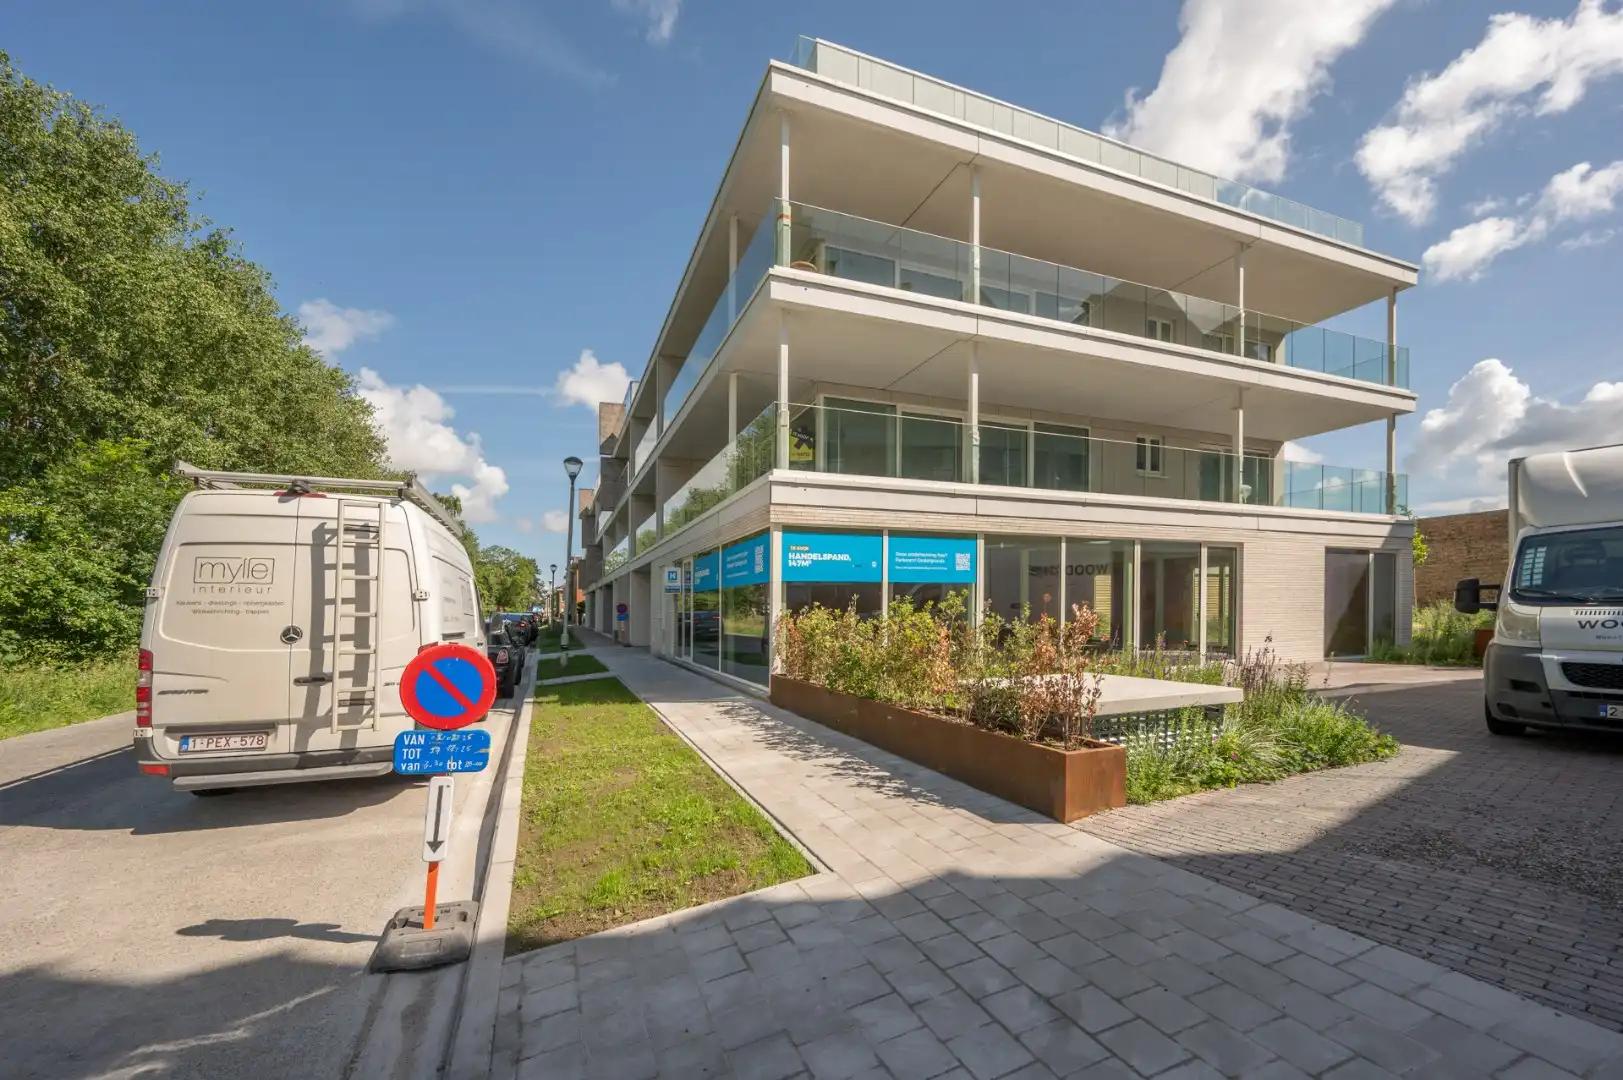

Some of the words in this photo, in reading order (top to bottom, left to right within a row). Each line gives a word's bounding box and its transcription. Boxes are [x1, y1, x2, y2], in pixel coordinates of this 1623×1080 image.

[788, 552, 852, 561] HANDELSPAND,
[198, 557, 269, 584] mylle
[192, 585, 272, 594] interieur
[1577, 619, 1623, 630] WO
[191, 735, 265, 749] 1-PEX-578
[403, 734, 425, 745] VAN
[402, 748, 422, 760] TOT
[401, 762, 420, 771] van
[446, 759, 462, 770] tot
